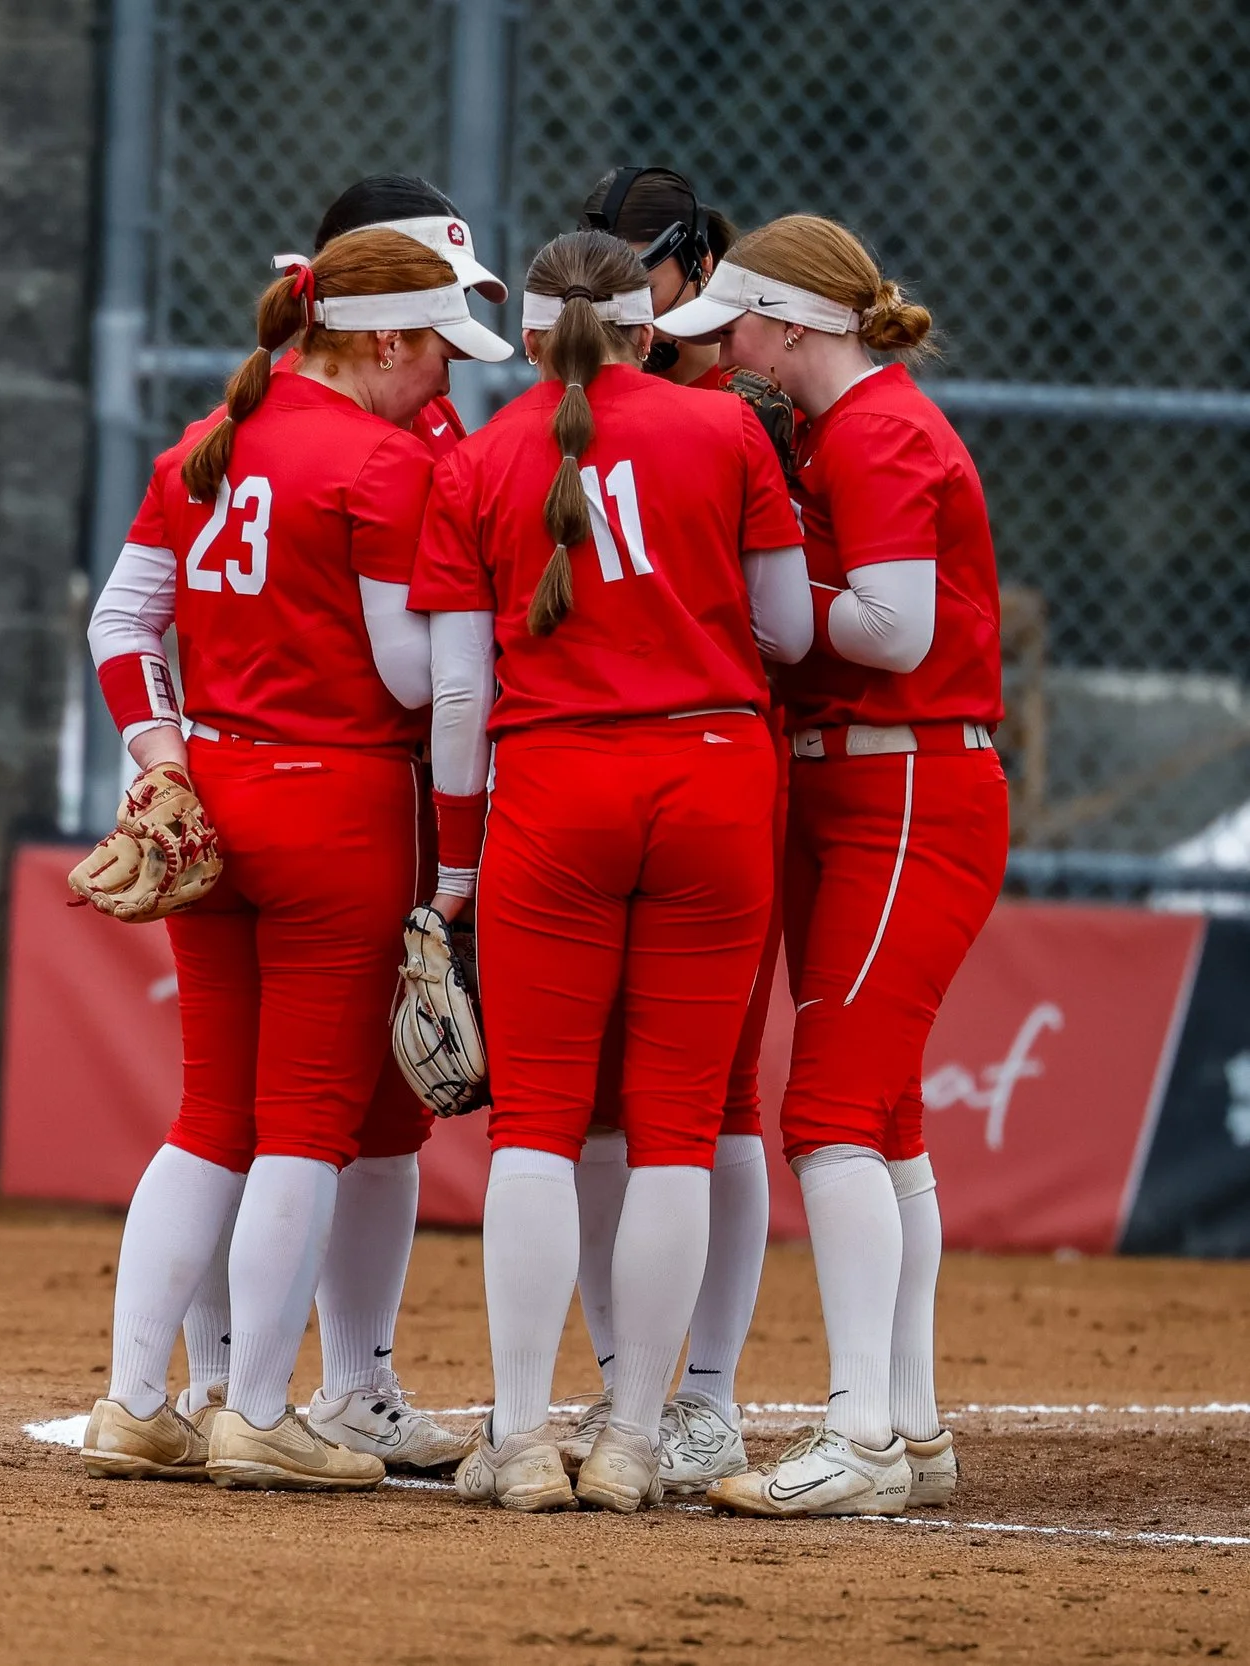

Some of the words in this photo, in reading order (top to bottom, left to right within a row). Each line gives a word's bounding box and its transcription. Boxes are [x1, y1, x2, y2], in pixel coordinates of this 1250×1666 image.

[186, 473, 273, 596] 23
[579, 459, 654, 583] 11
[922, 1003, 1064, 1152] af
